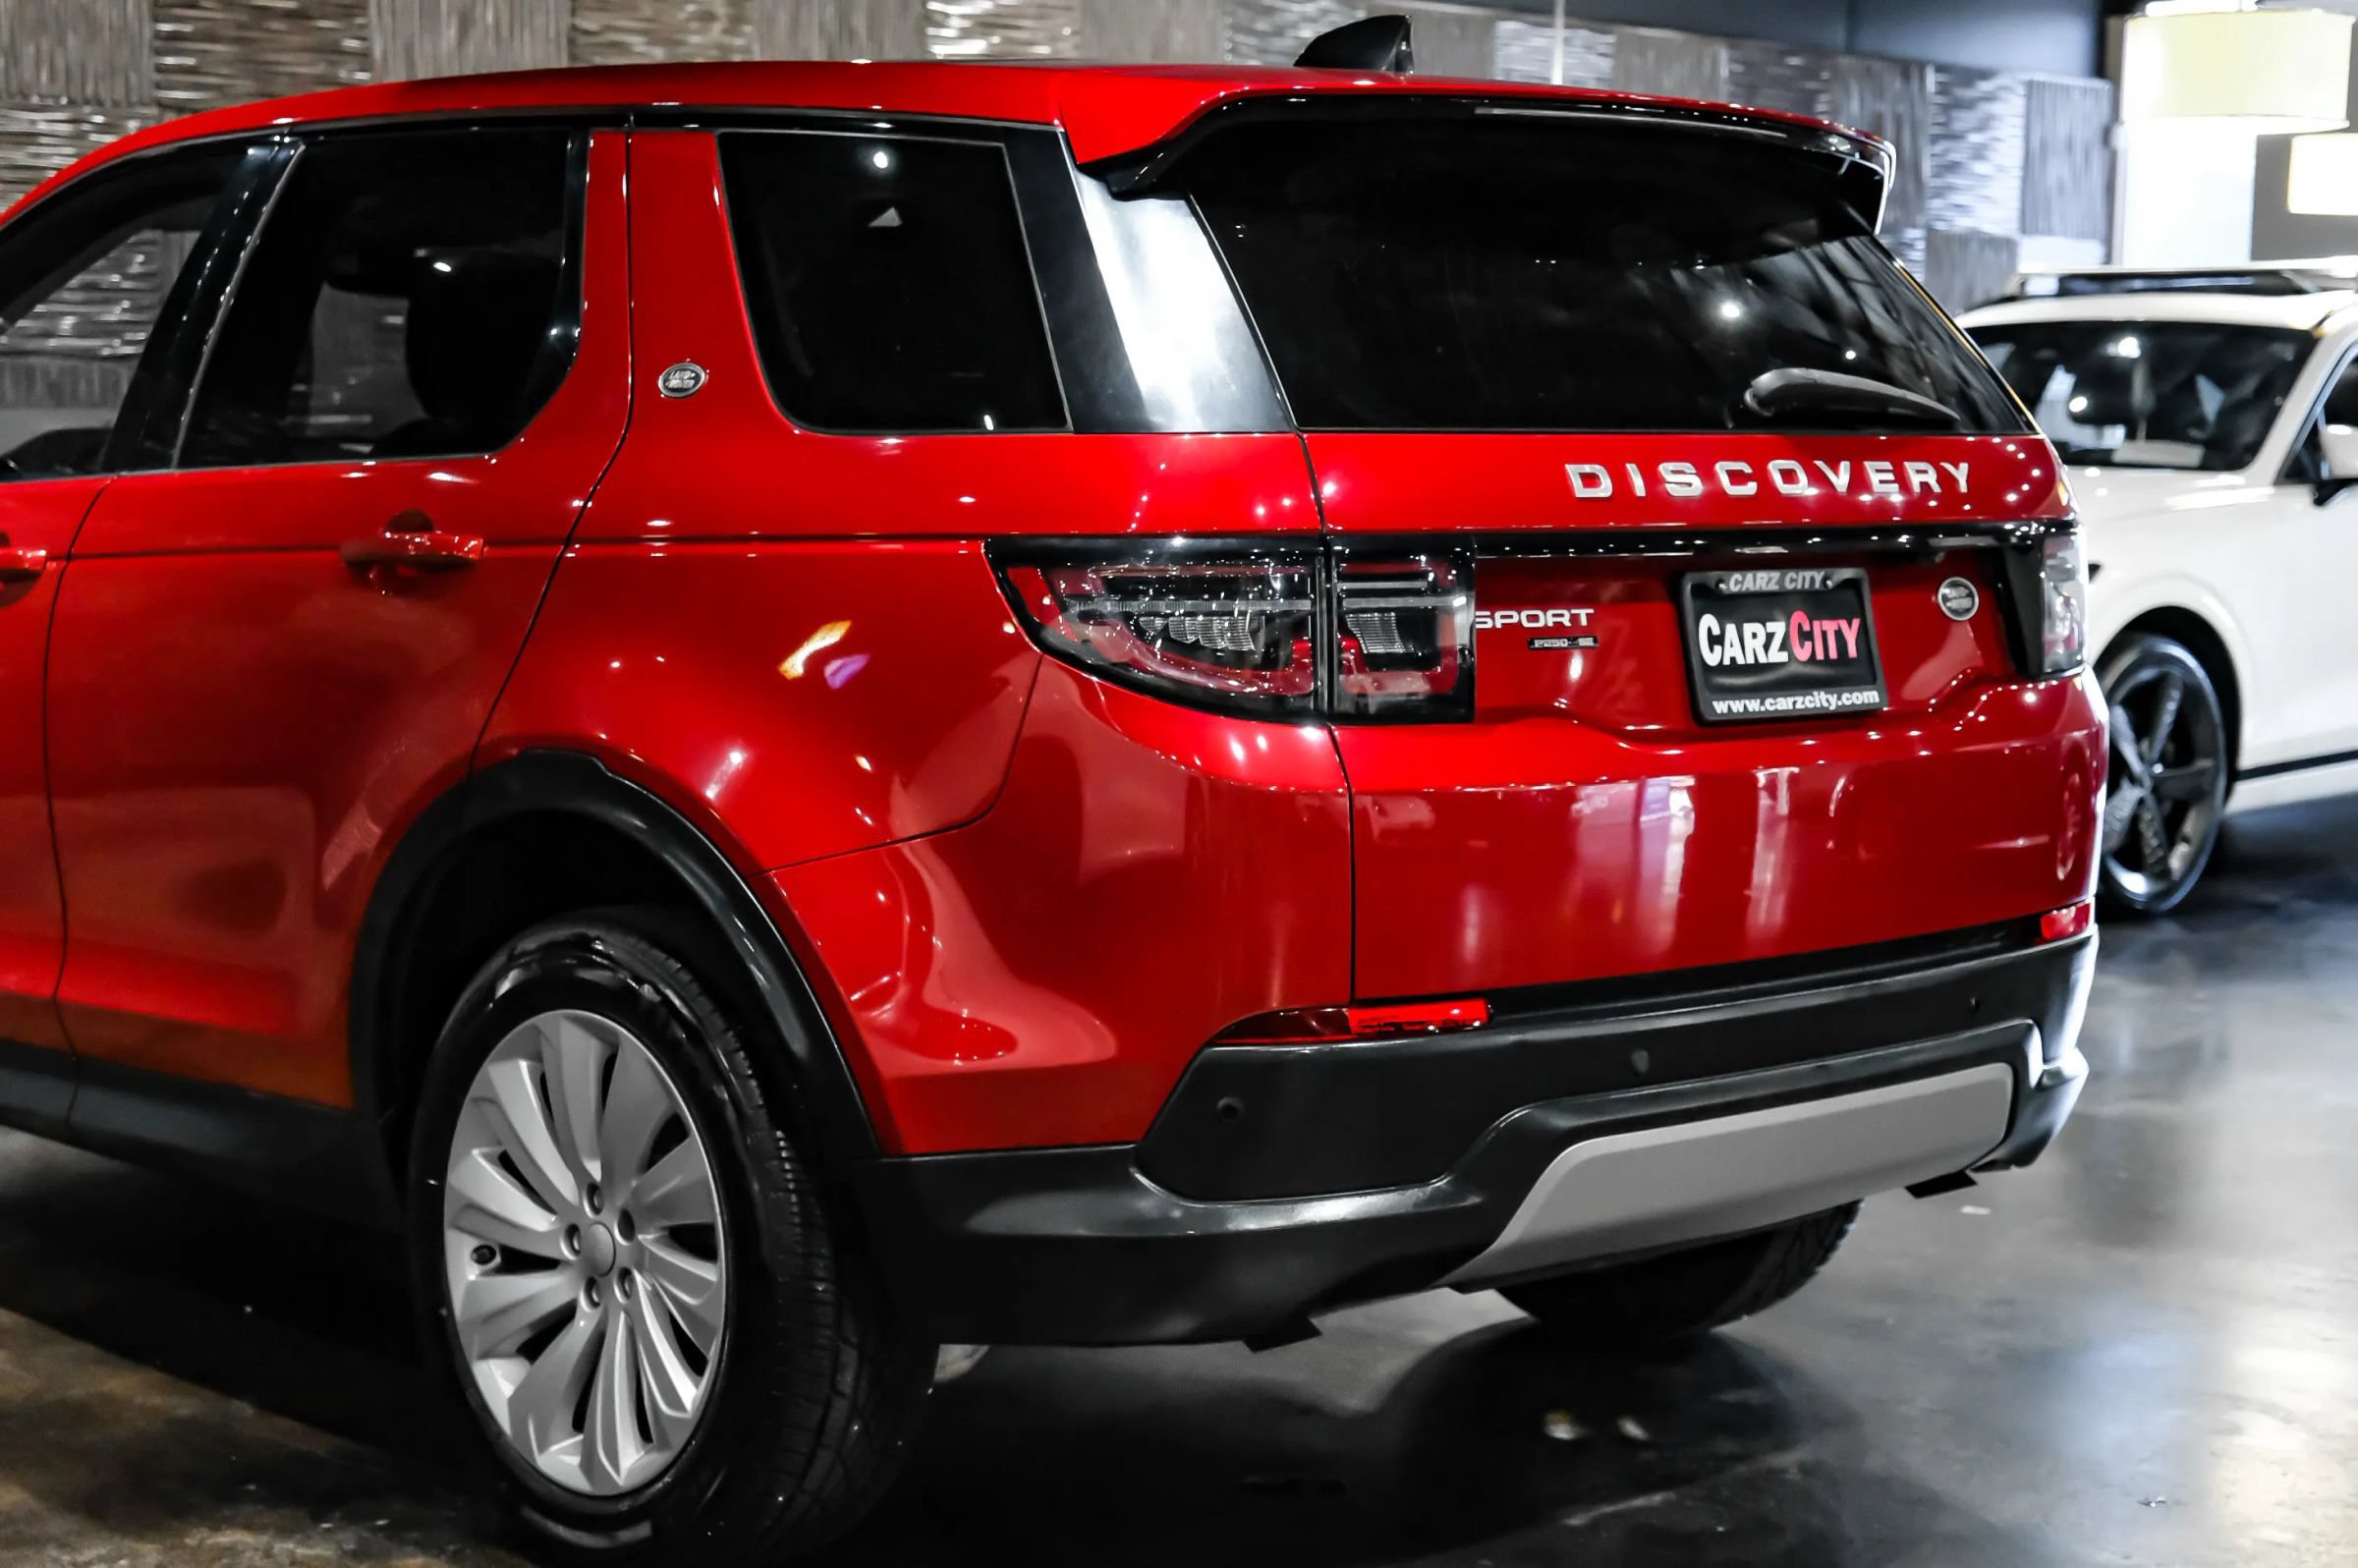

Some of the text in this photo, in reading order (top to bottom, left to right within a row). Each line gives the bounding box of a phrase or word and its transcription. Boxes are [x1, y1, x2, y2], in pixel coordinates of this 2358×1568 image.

[1565, 459, 1969, 499] DISCOVERY
[1728, 571, 1825, 591] CARZ CITY
[1475, 608, 1595, 629] SPORT
[1712, 690, 1881, 714] www.carzcity.com
